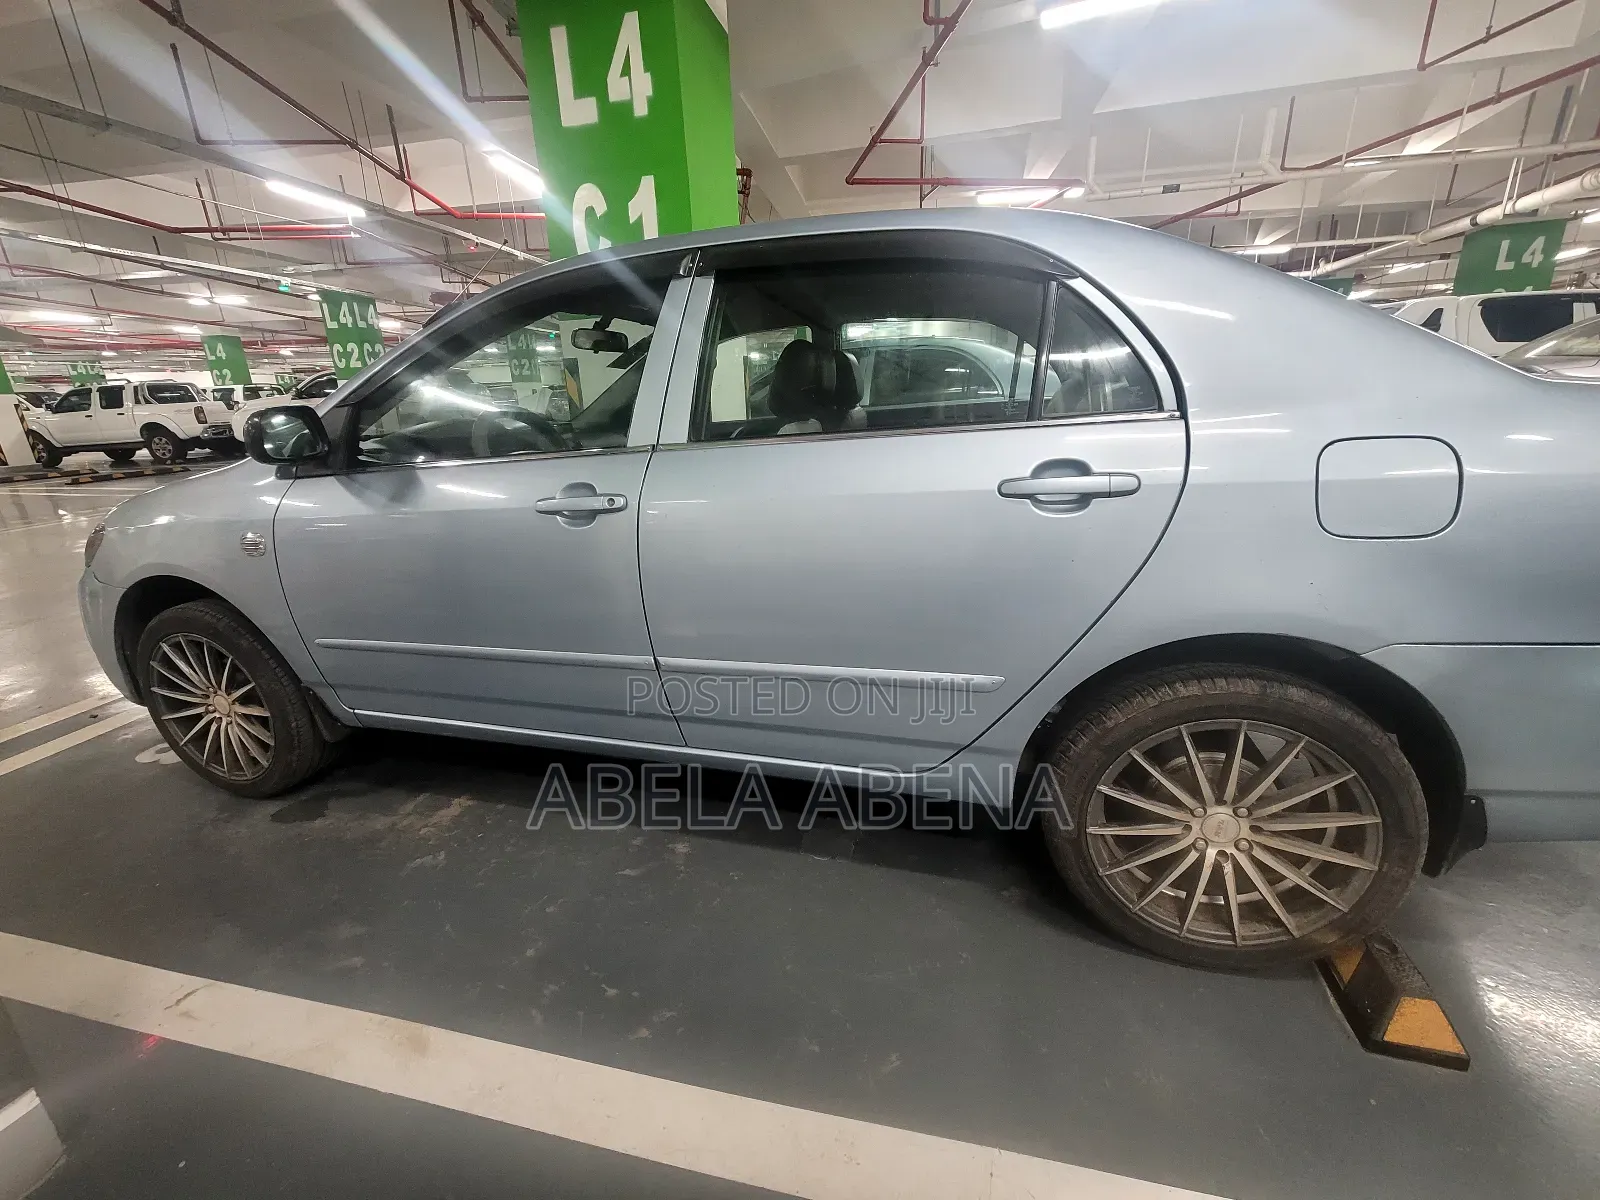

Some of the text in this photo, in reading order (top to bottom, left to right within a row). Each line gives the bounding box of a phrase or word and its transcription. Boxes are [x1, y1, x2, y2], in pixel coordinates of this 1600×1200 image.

[550, 11, 653, 127] L4
[572, 175, 659, 255] C1
[1495, 236, 1546, 271] L4
[322, 301, 352, 328] L4
[353, 302, 379, 329] L4
[204, 343, 226, 360] L4
[333, 342, 362, 369] C2
[212, 368, 234, 386] C2
[511, 359, 531, 375] C2
